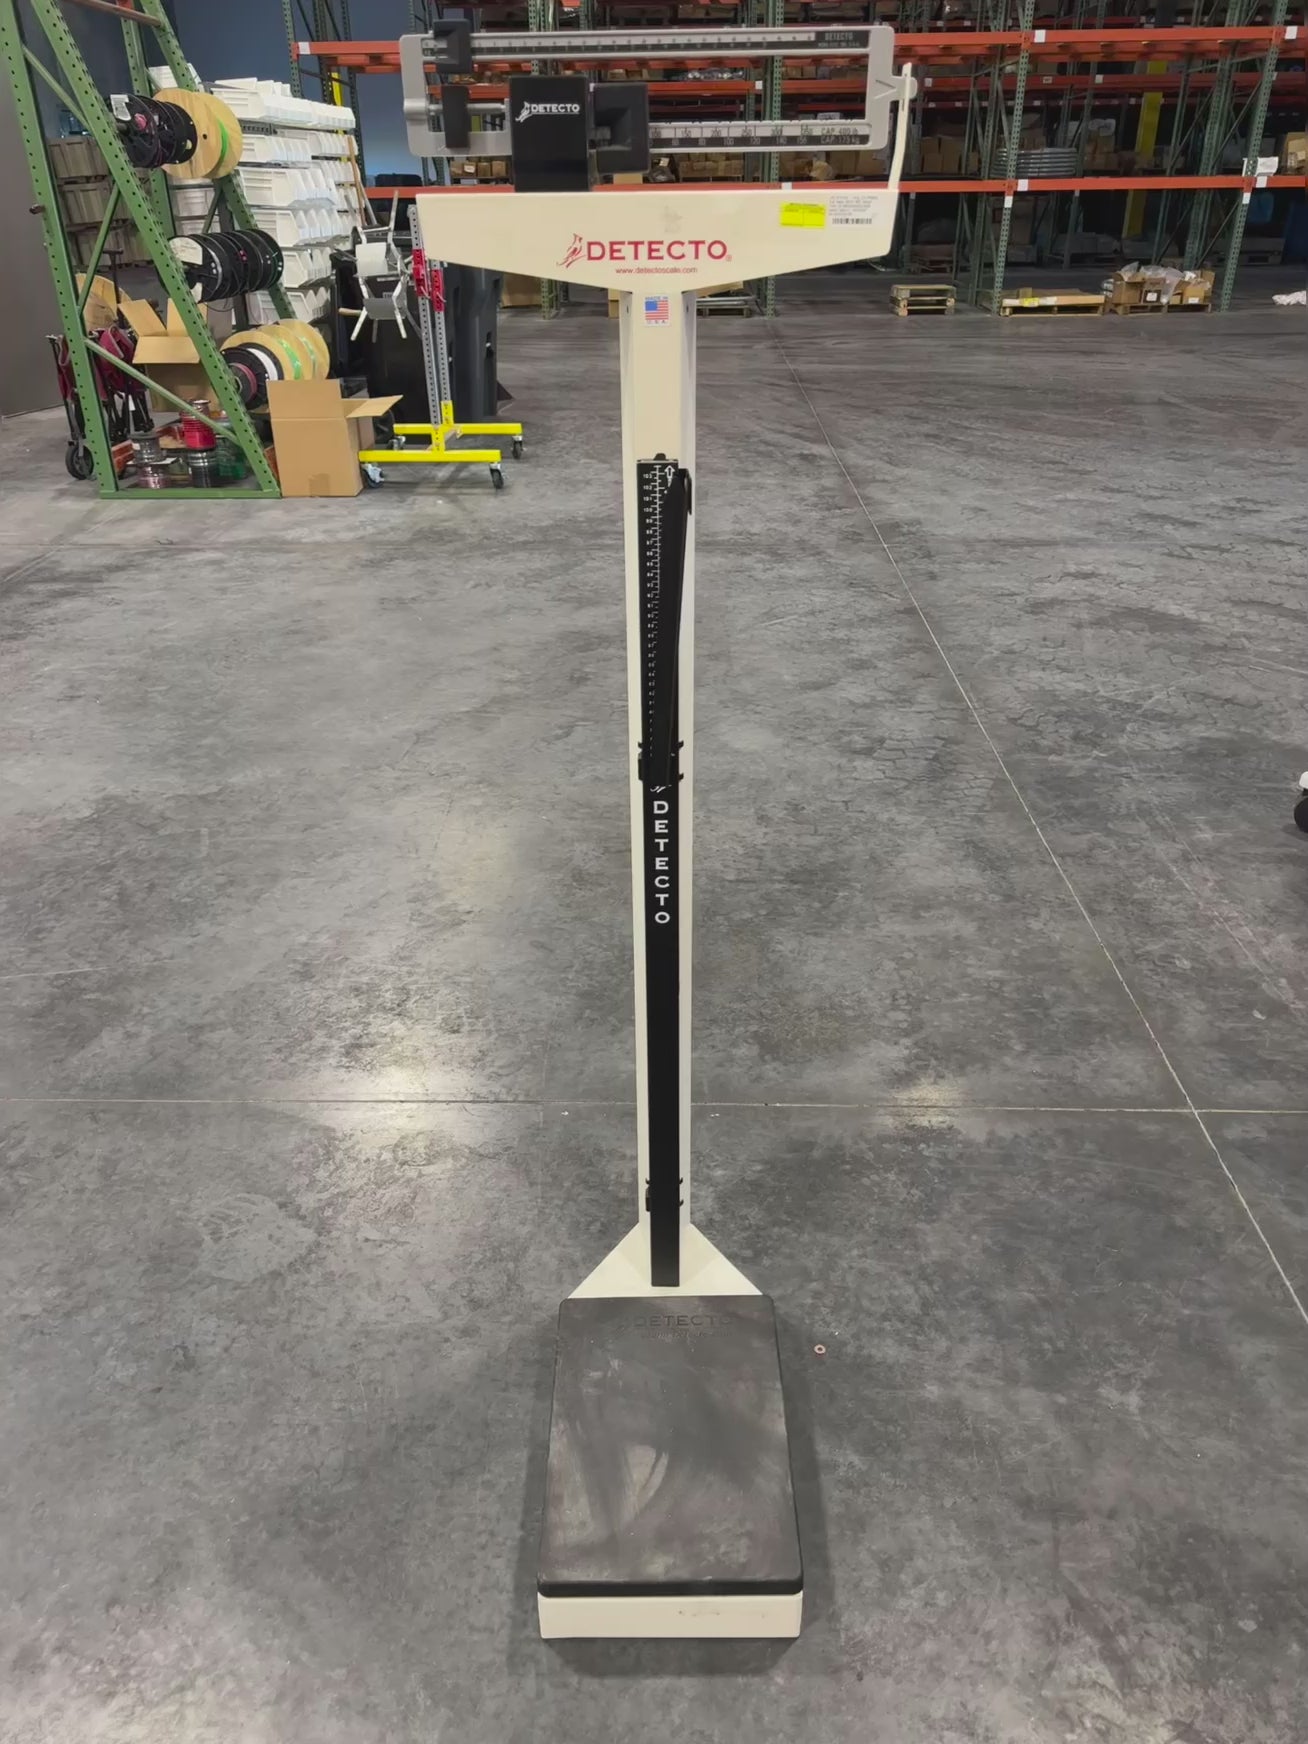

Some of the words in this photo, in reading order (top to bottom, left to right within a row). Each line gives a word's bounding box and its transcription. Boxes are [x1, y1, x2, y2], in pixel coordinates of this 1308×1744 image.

[529, 103, 581, 114] DETECTO
[723, 136, 735, 146] 100
[586, 240, 728, 261] DETECTO
[615, 266, 698, 275] www.detectoscale.com
[653, 800, 671, 924] DETECTO
[633, 1314, 731, 1328] DETECTO
